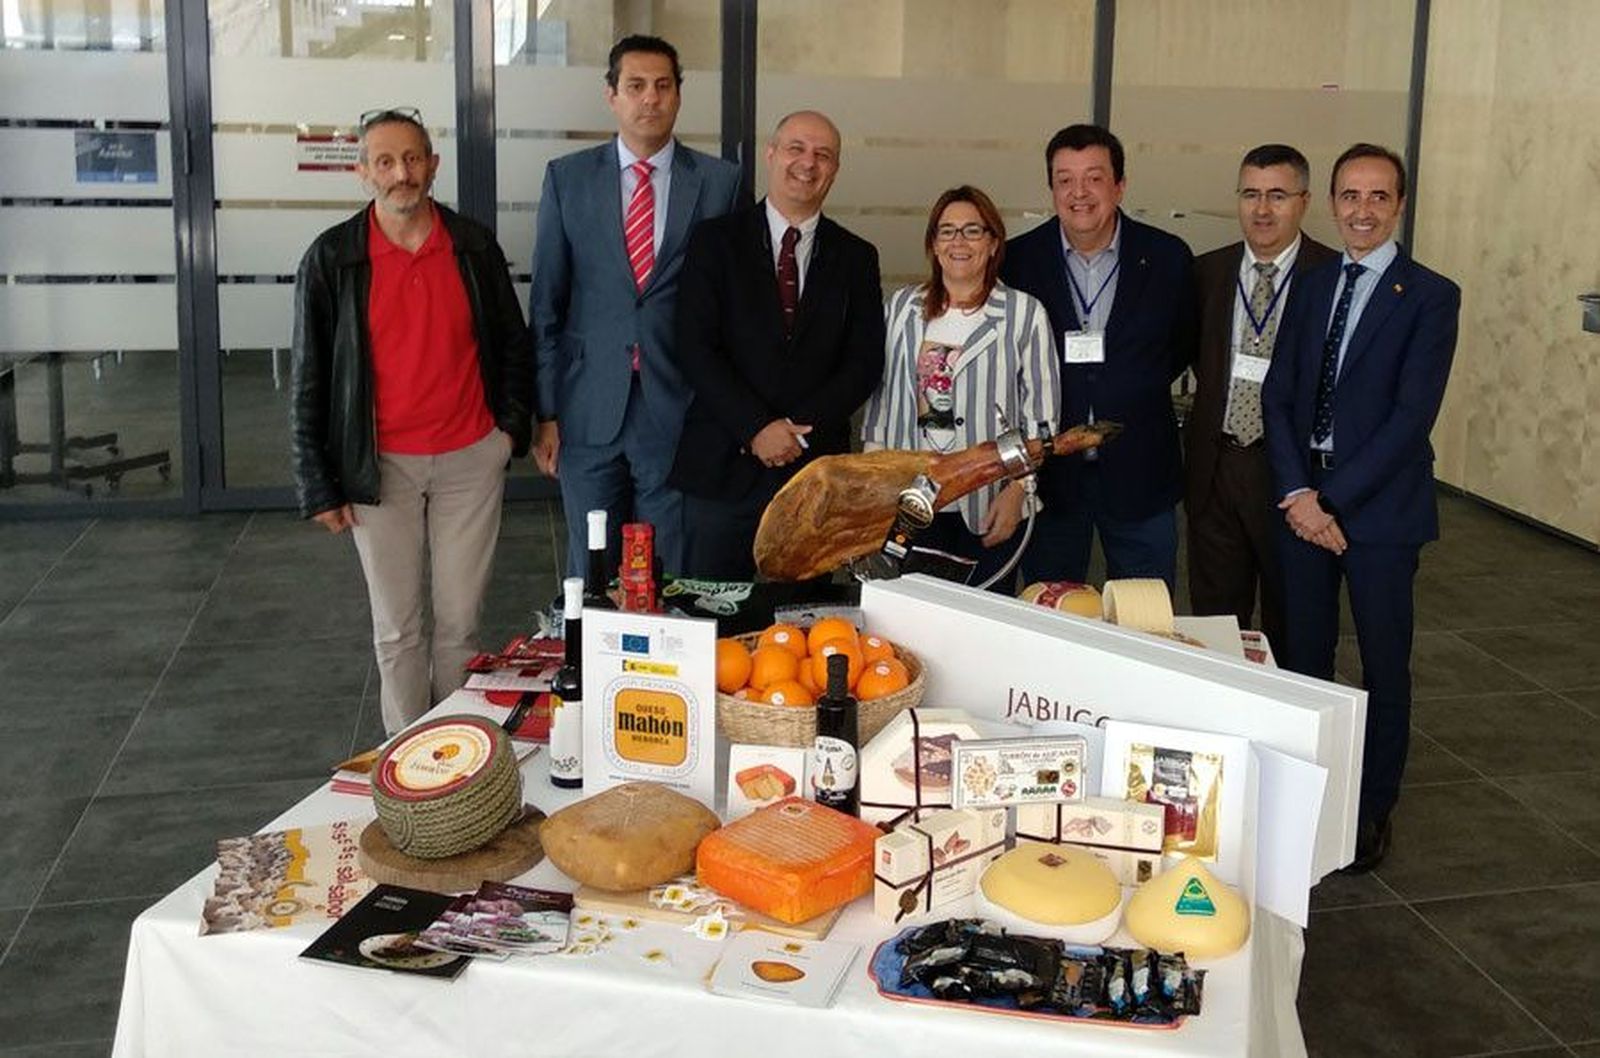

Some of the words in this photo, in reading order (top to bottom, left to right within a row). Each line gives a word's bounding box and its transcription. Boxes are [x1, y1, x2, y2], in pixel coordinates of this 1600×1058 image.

[635, 702, 667, 716] QUESO
[618, 710, 684, 738] mahón
[631, 734, 670, 746] MENORCA
